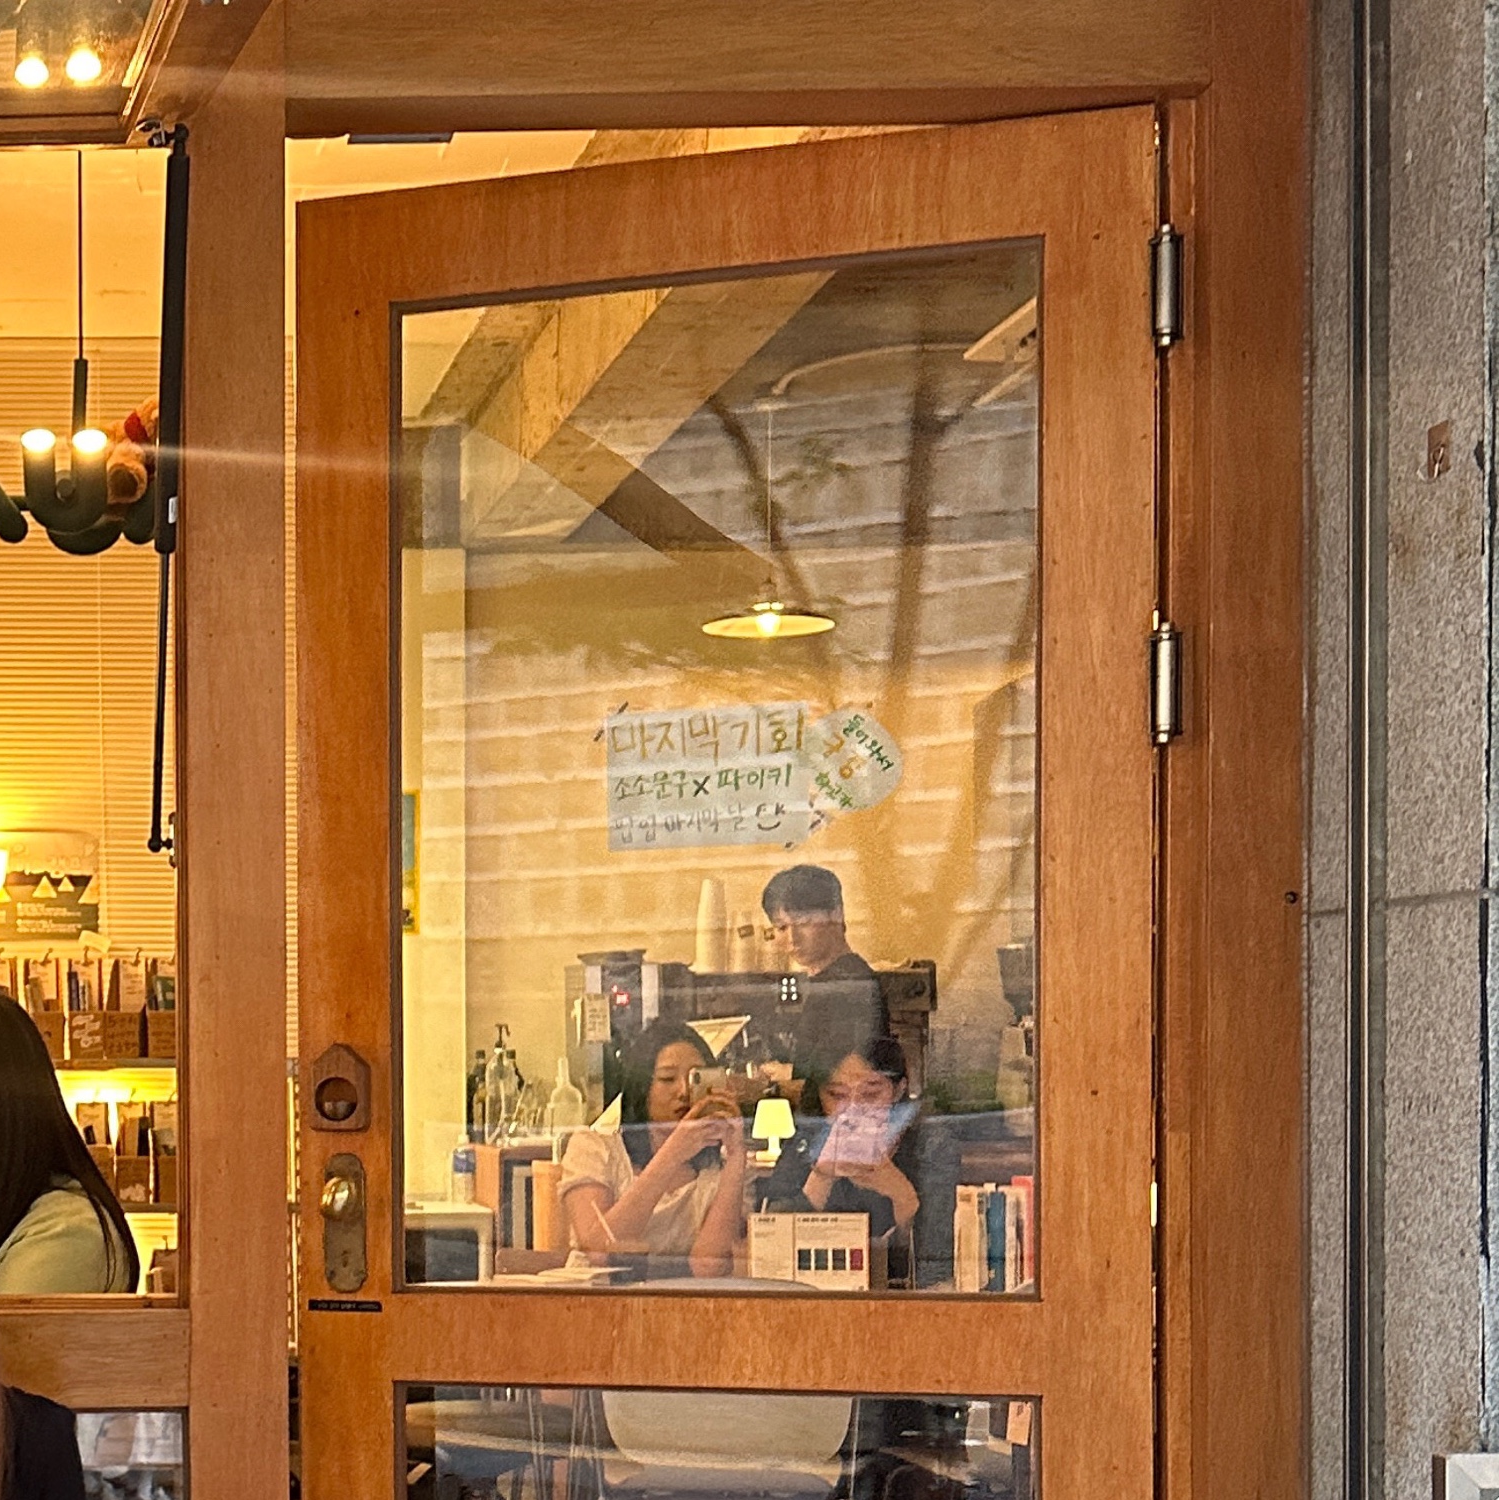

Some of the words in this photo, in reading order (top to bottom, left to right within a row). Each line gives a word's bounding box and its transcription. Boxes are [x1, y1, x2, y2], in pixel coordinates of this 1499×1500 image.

[610, 714, 720, 766] 마지막
[730, 709, 805, 757] 기회
[717, 762, 793, 791] 파이키
